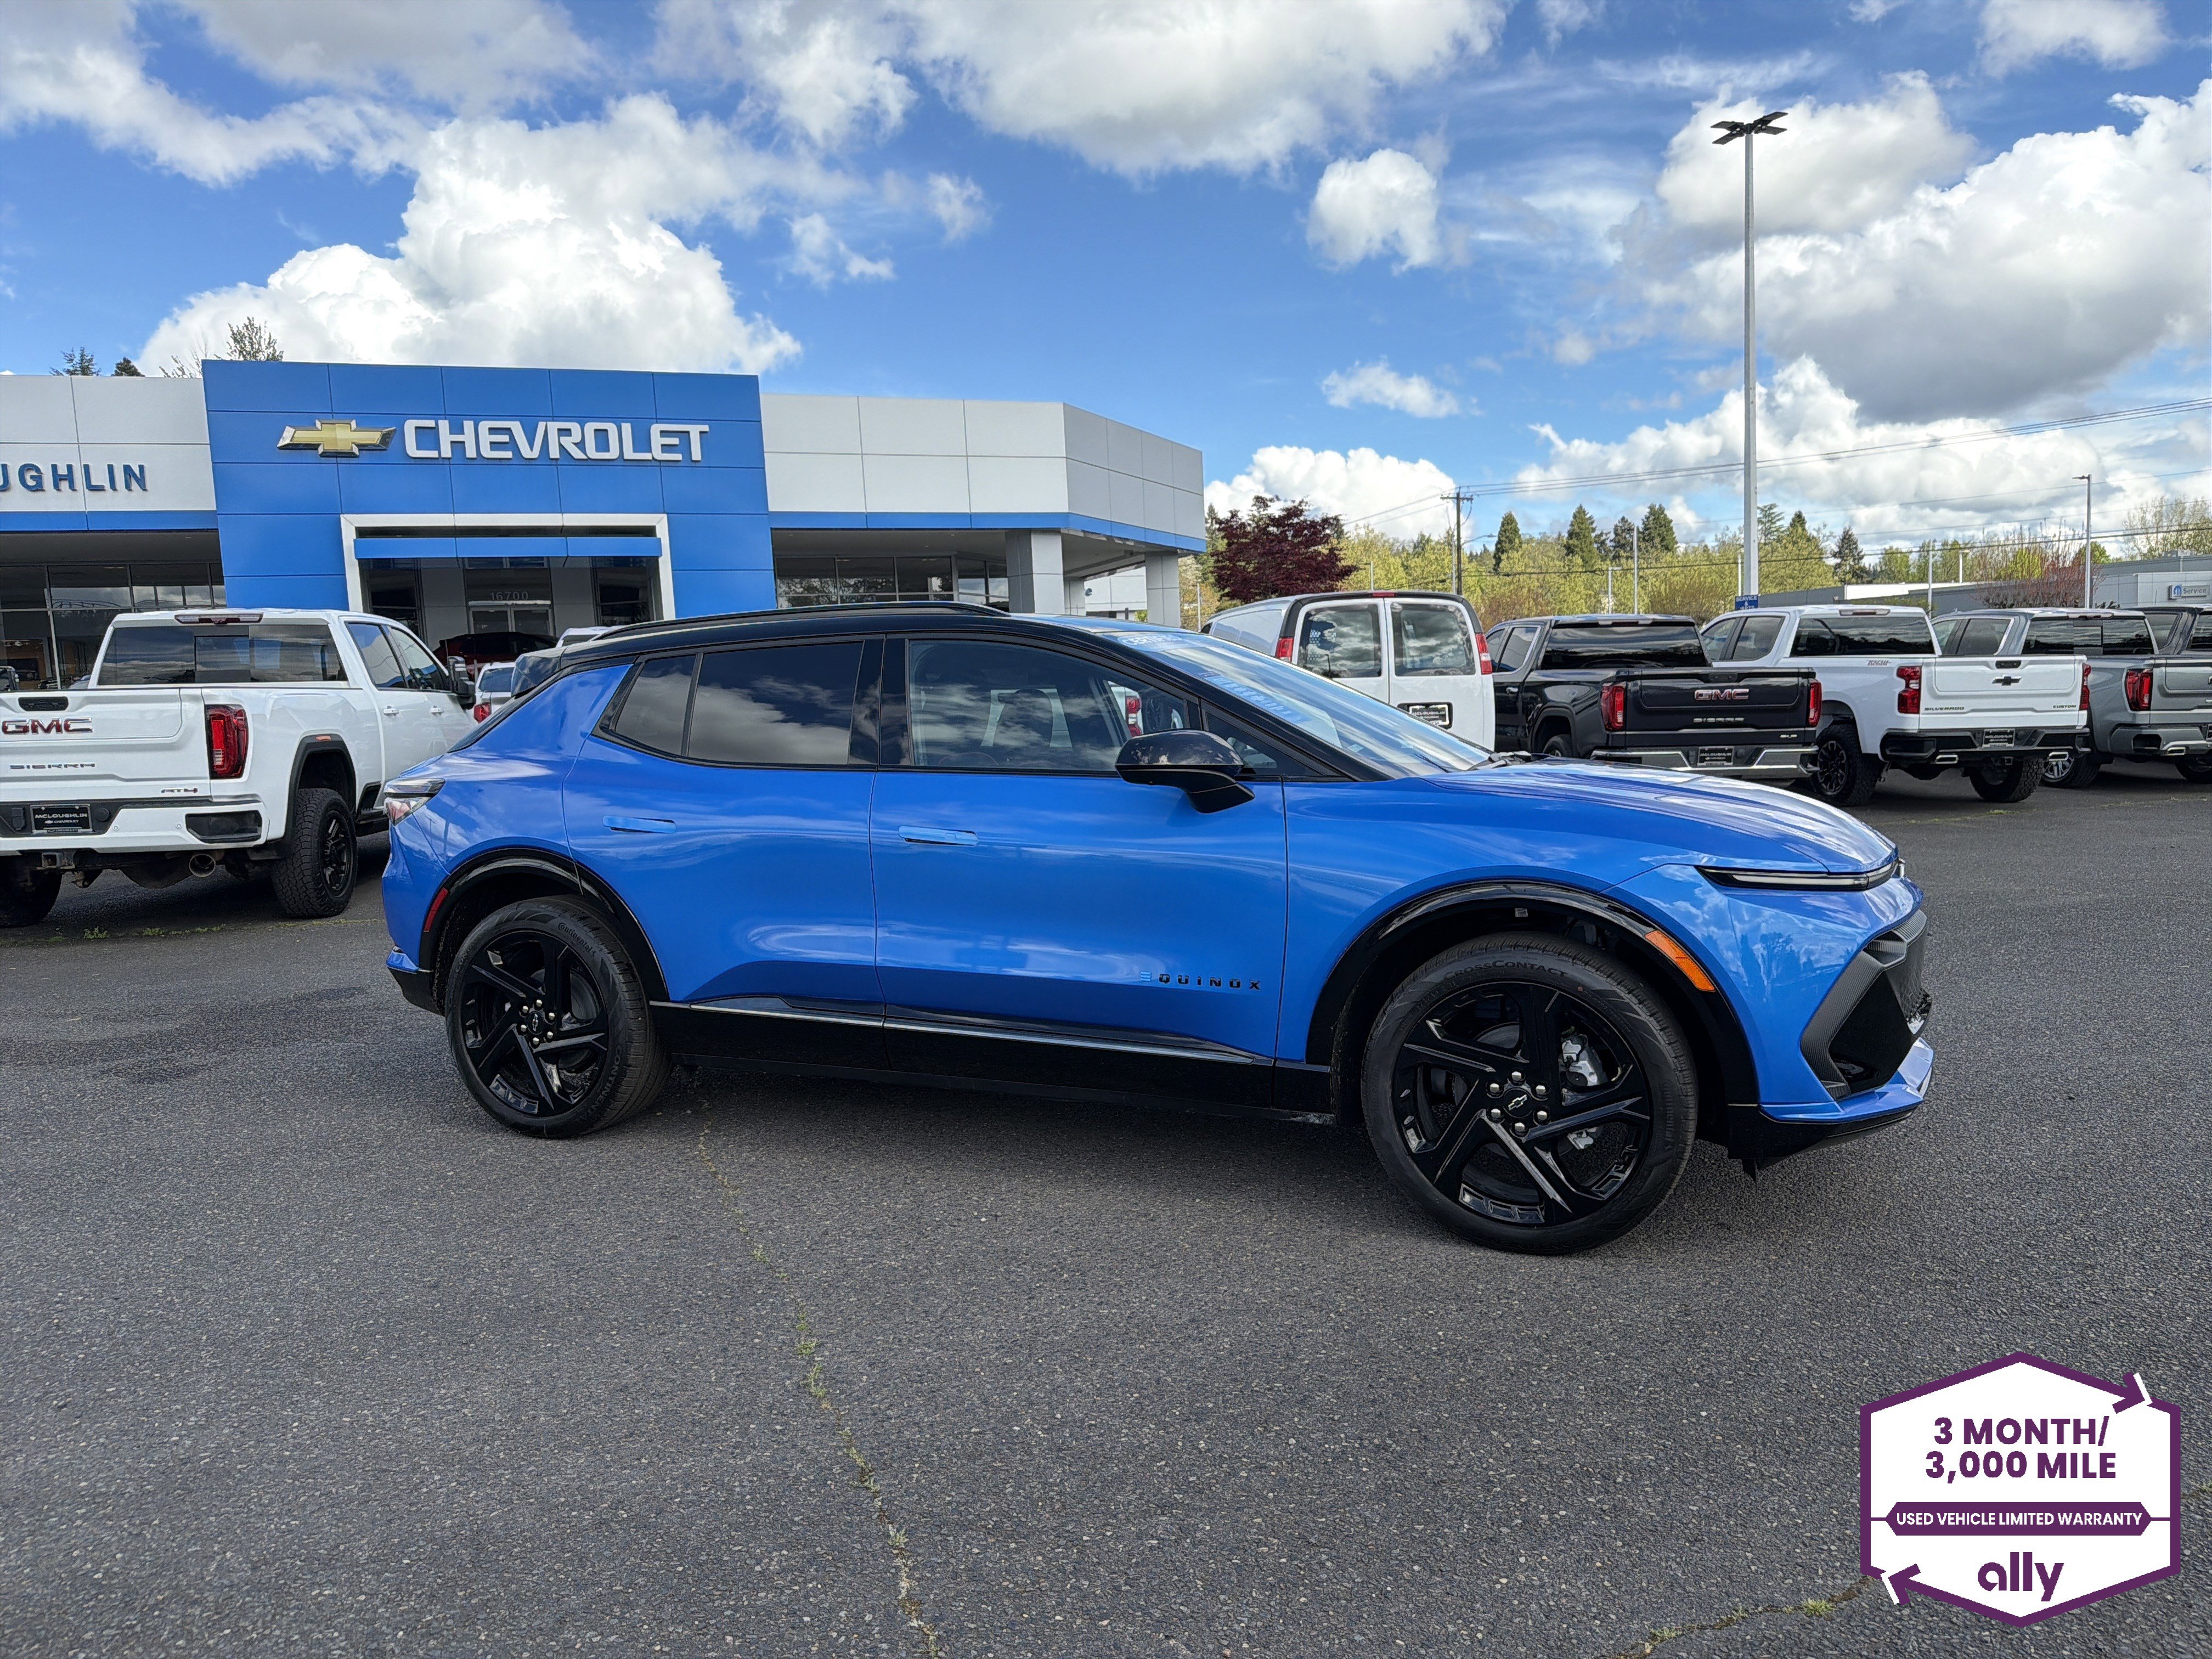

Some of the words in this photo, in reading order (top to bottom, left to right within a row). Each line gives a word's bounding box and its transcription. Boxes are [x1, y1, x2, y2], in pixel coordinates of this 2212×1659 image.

[404, 419, 709, 462] CHEVROLET
[490, 591, 528, 601] 16700
[1695, 689, 1749, 701] GMC
[2, 718, 93, 735] GMC
[558, 922, 593, 952] Continental
[1140, 971, 1261, 990] EQUINOX
